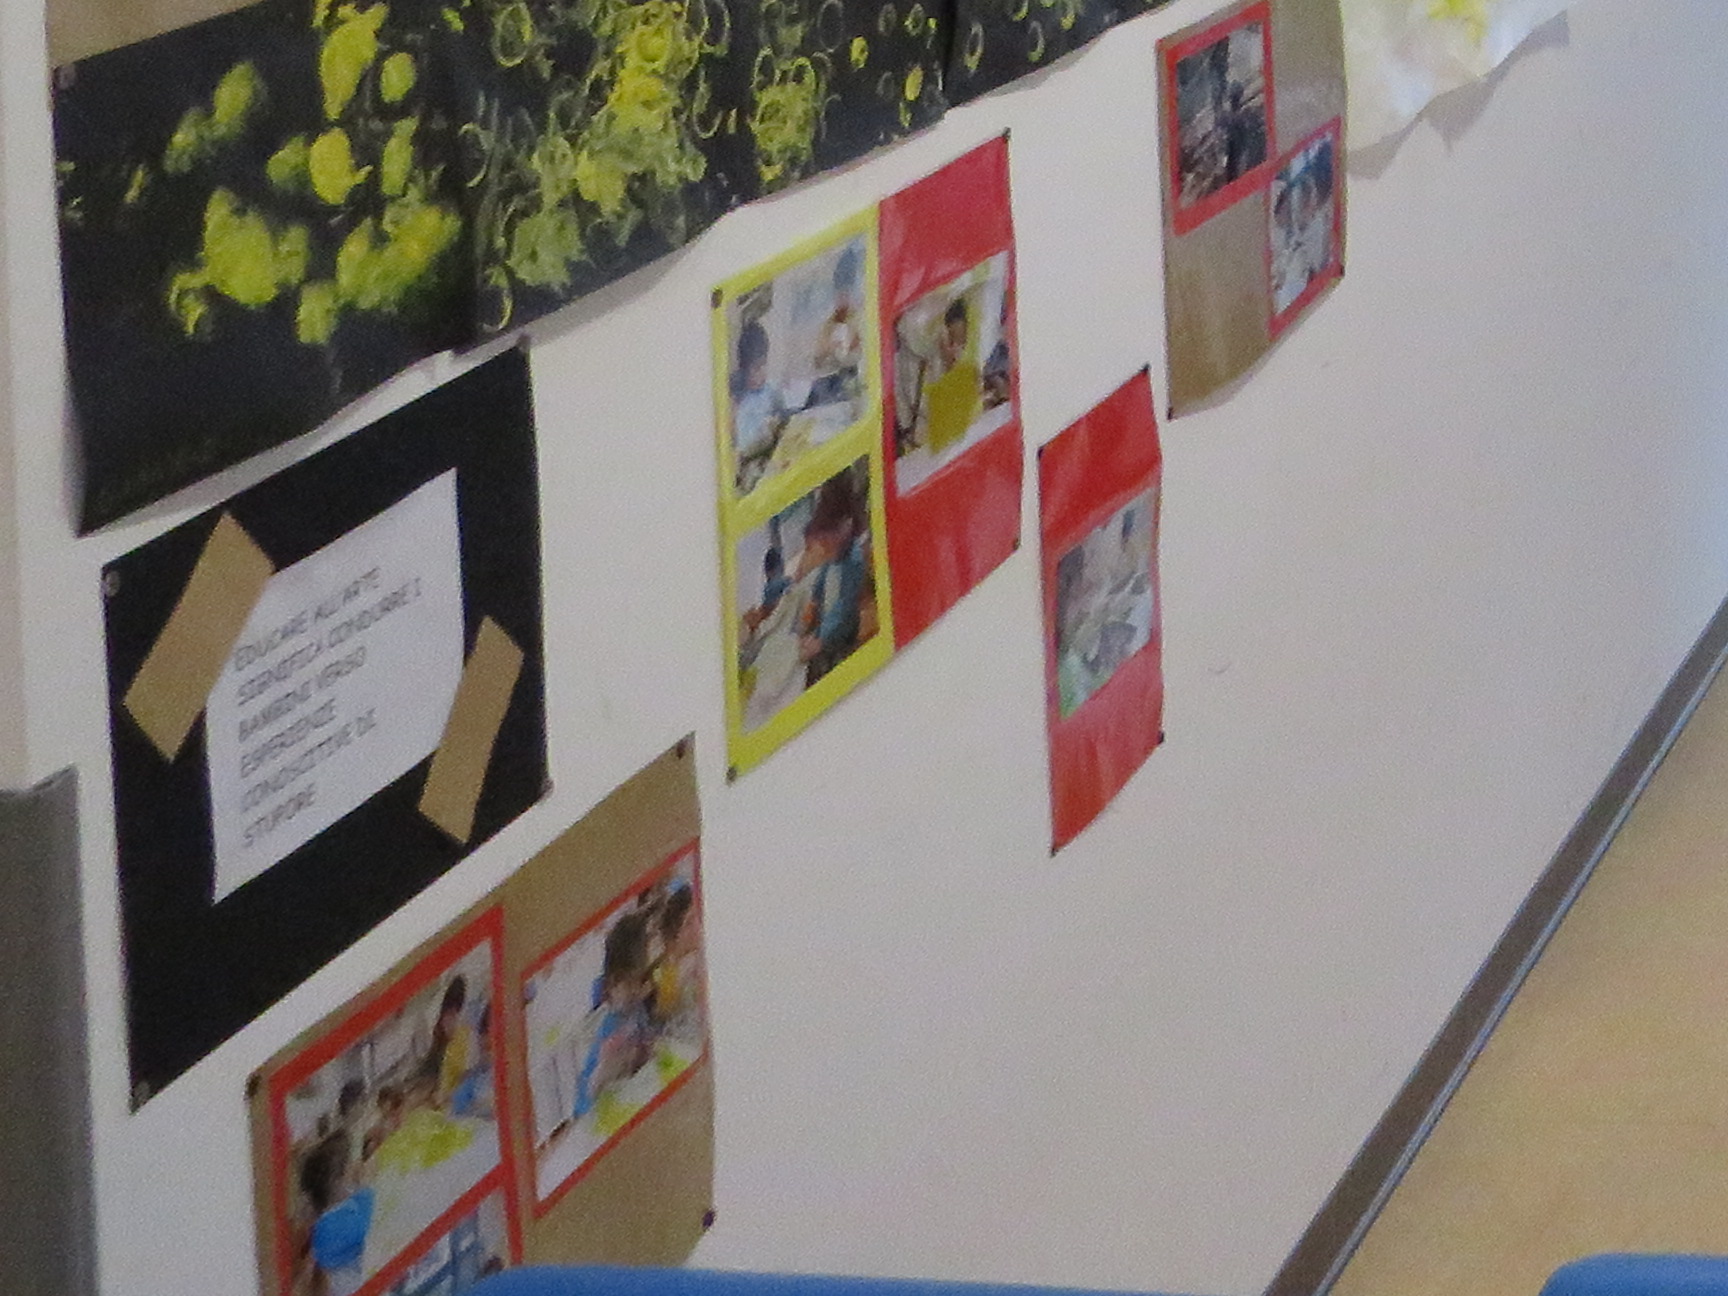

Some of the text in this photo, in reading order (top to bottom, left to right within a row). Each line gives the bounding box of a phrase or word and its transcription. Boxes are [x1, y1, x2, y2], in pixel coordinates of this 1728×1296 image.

[236, 608, 308, 671] EDUCARE
[318, 646, 367, 689] VERSO
[241, 698, 337, 778] ESPERIENZE
[243, 782, 317, 848] STUPORE
